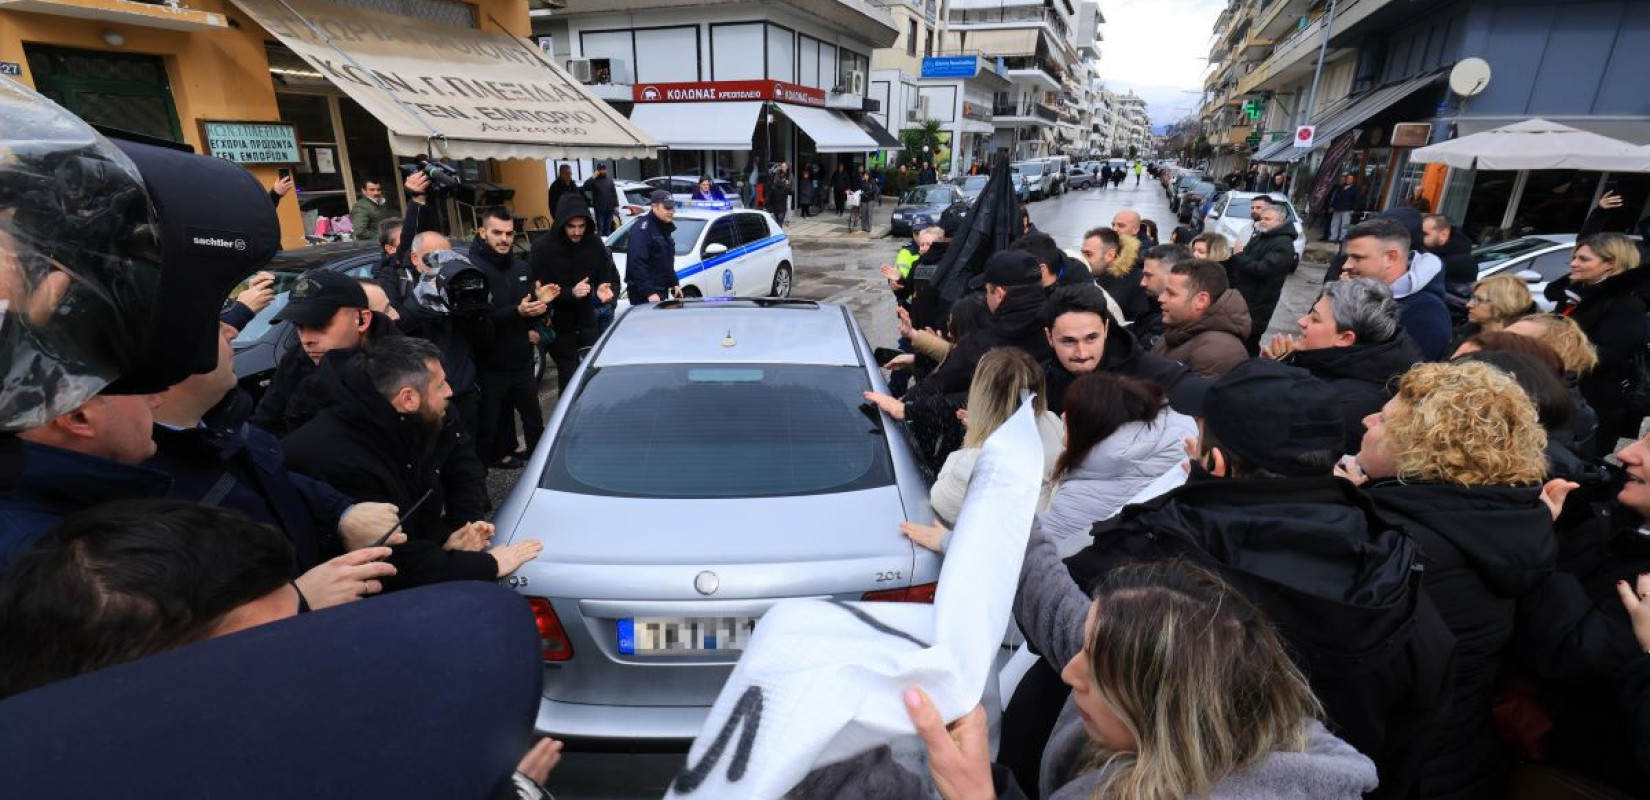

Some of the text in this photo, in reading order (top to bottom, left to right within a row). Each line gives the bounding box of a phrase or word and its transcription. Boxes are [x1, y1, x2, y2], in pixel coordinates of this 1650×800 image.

[667, 88, 716, 100] ΚΟΛΩΝΑΣ
[475, 106, 597, 124] ΕΜΠΟΡΙΟ
[193, 237, 234, 248] sachtler
